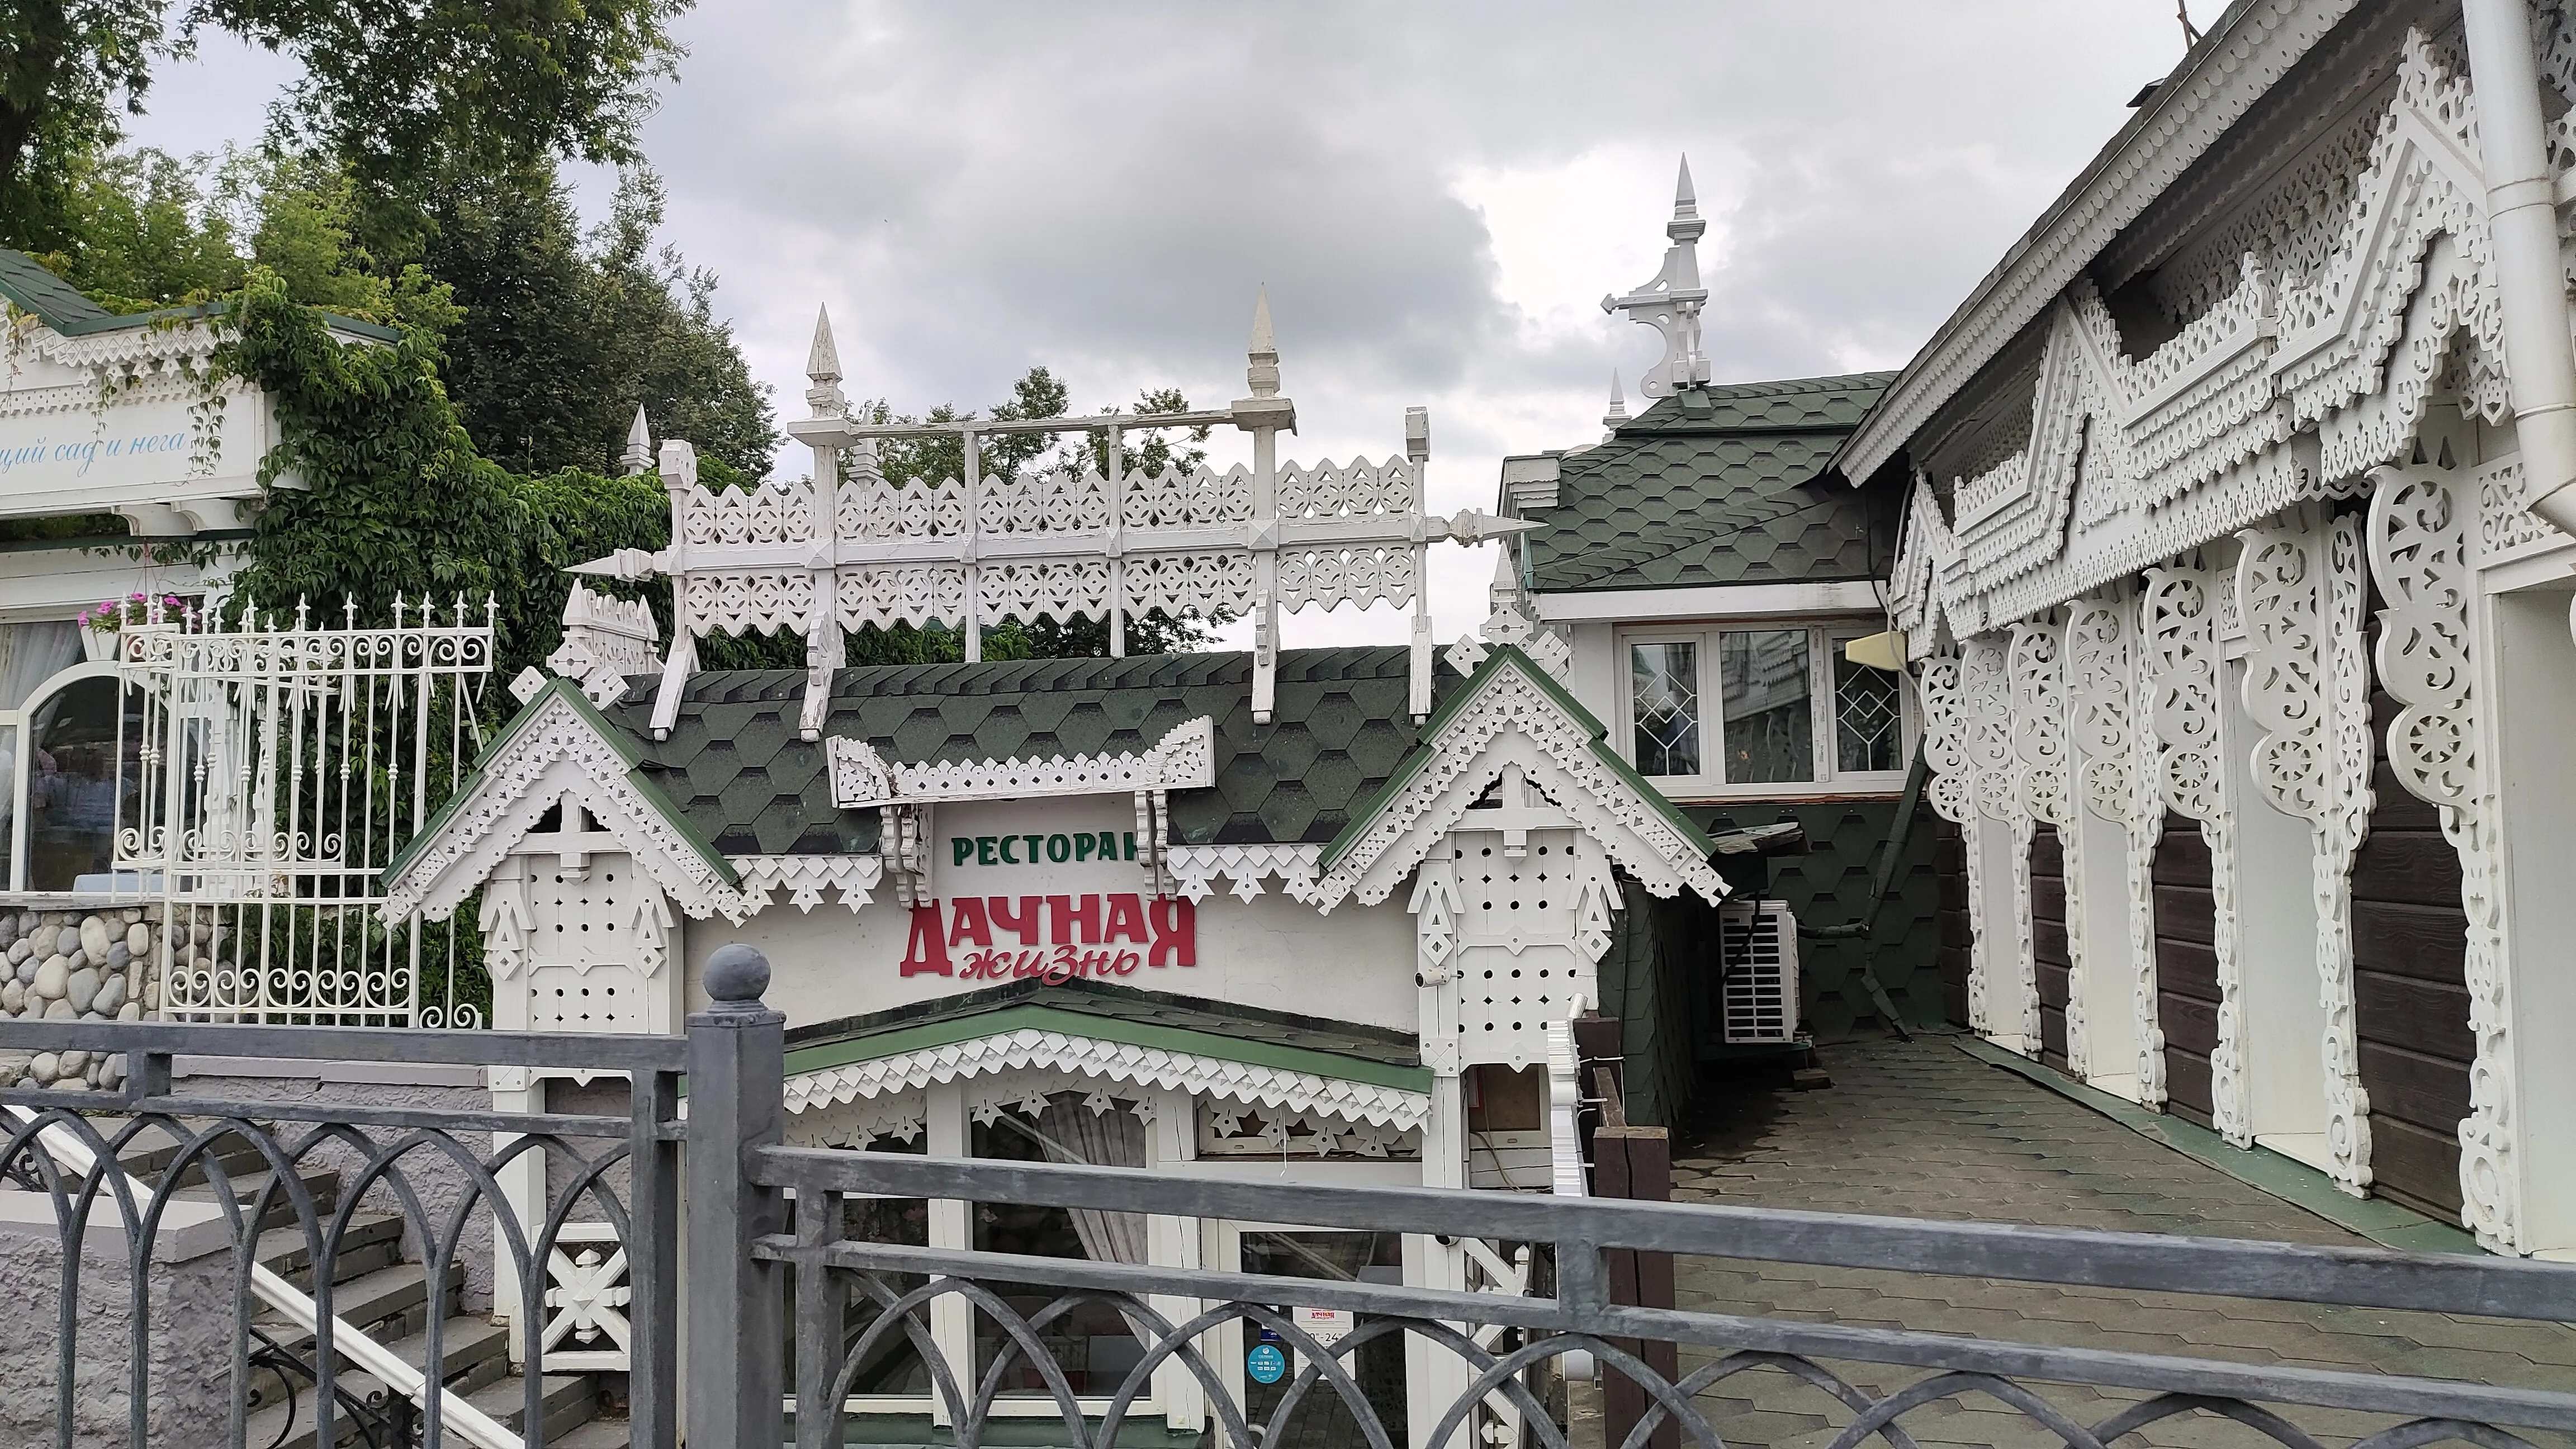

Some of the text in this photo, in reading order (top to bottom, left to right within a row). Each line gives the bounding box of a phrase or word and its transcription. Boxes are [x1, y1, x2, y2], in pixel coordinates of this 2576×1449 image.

[55, 442, 96, 477] сад
[106, 439, 122, 457] и
[129, 433, 186, 455] нега
[900, 893, 1196, 977] ДАЧНАЯ
[959, 944, 1139, 986] жизнь
